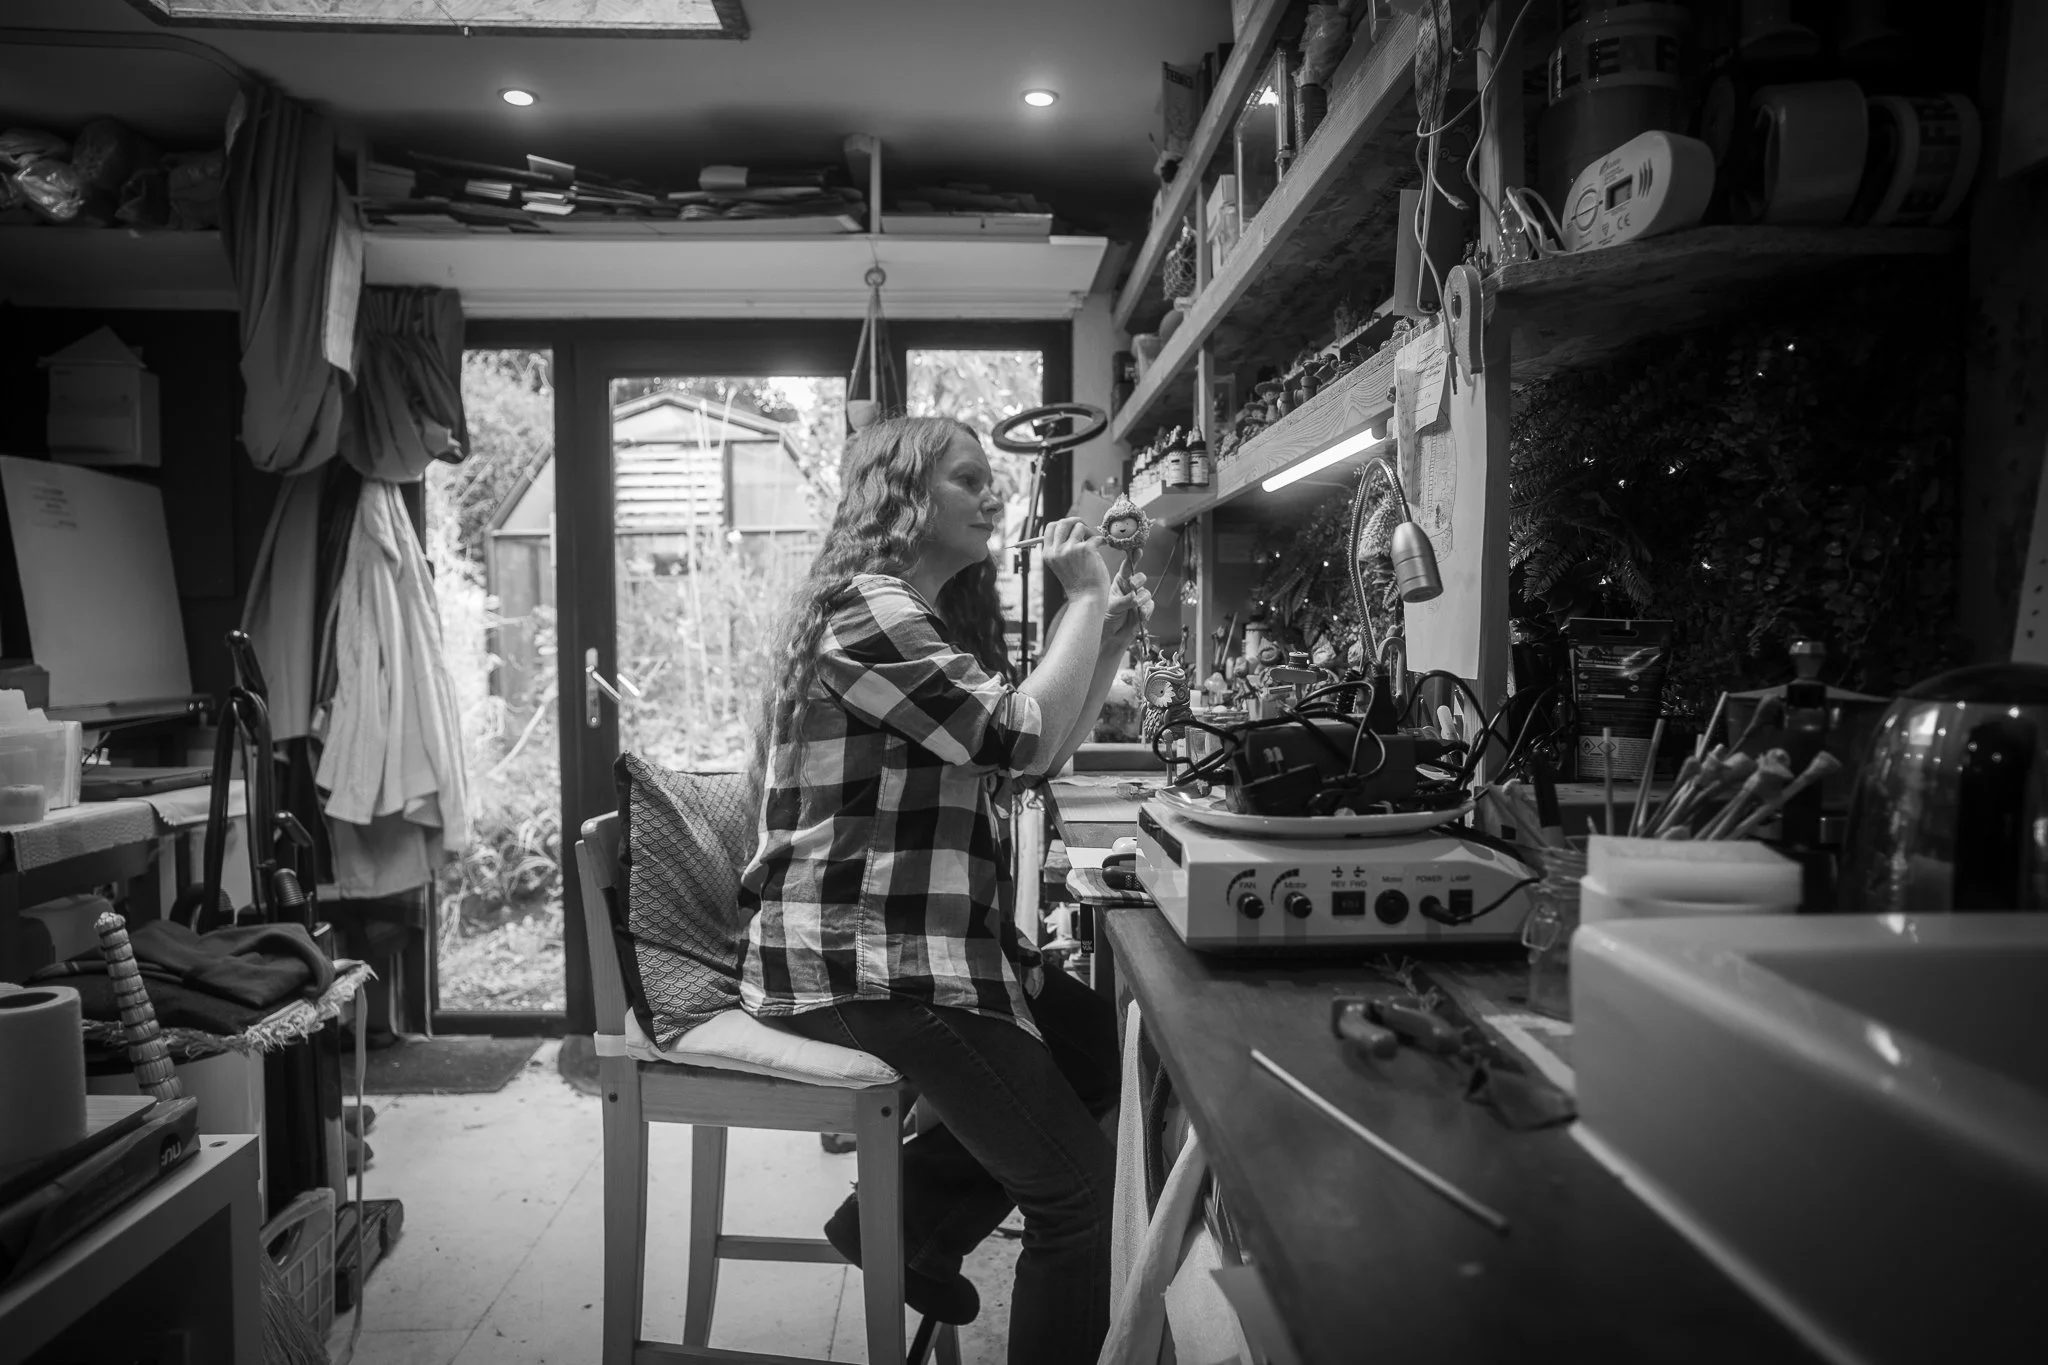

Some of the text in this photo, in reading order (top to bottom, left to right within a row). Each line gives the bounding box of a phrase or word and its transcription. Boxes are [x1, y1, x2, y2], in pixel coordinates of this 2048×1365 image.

[1415, 875, 1443, 883] POWER
[1450, 874, 1472, 882] LAMP
[1238, 881, 1257, 890] FAN
[1283, 881, 1308, 889] Motor
[1331, 880, 1368, 888] REV FWD
